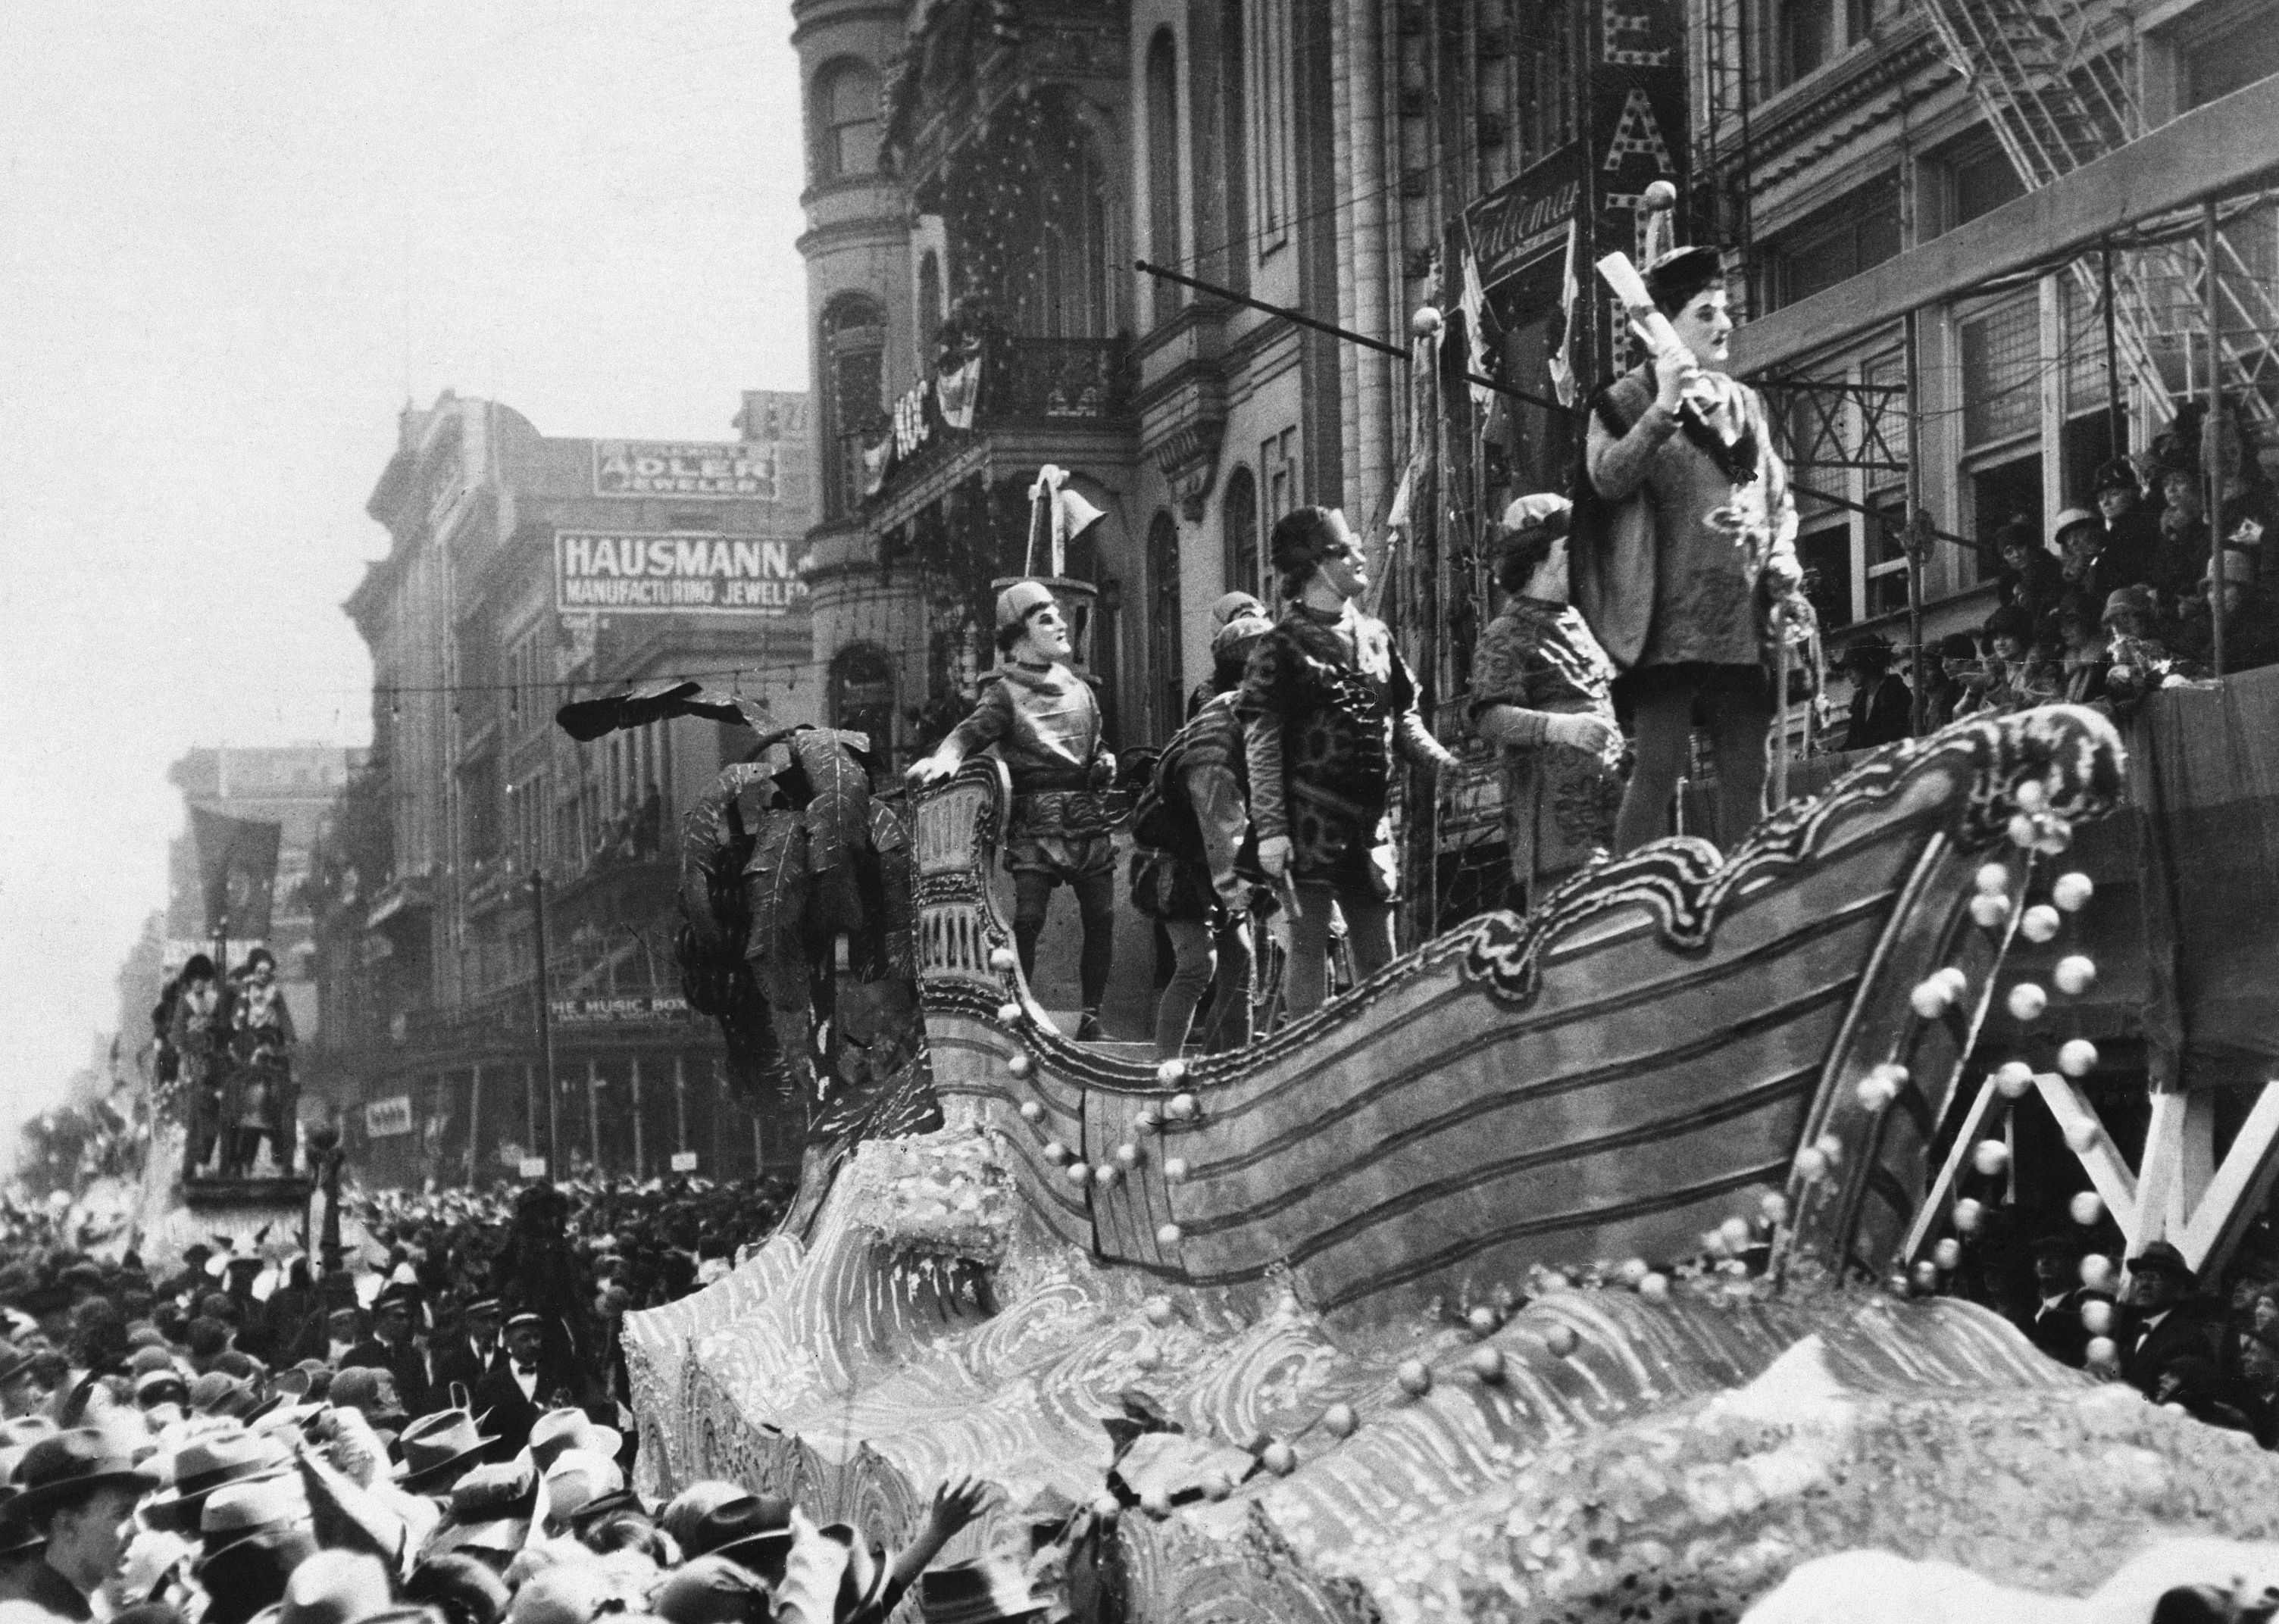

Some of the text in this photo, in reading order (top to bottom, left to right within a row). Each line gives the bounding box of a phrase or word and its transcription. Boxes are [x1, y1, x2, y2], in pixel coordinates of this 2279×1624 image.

[602, 457, 768, 478] ADLER
[566, 579, 714, 604] MANUFACTURING
[549, 997, 688, 1013] HE MUSIC BOX
